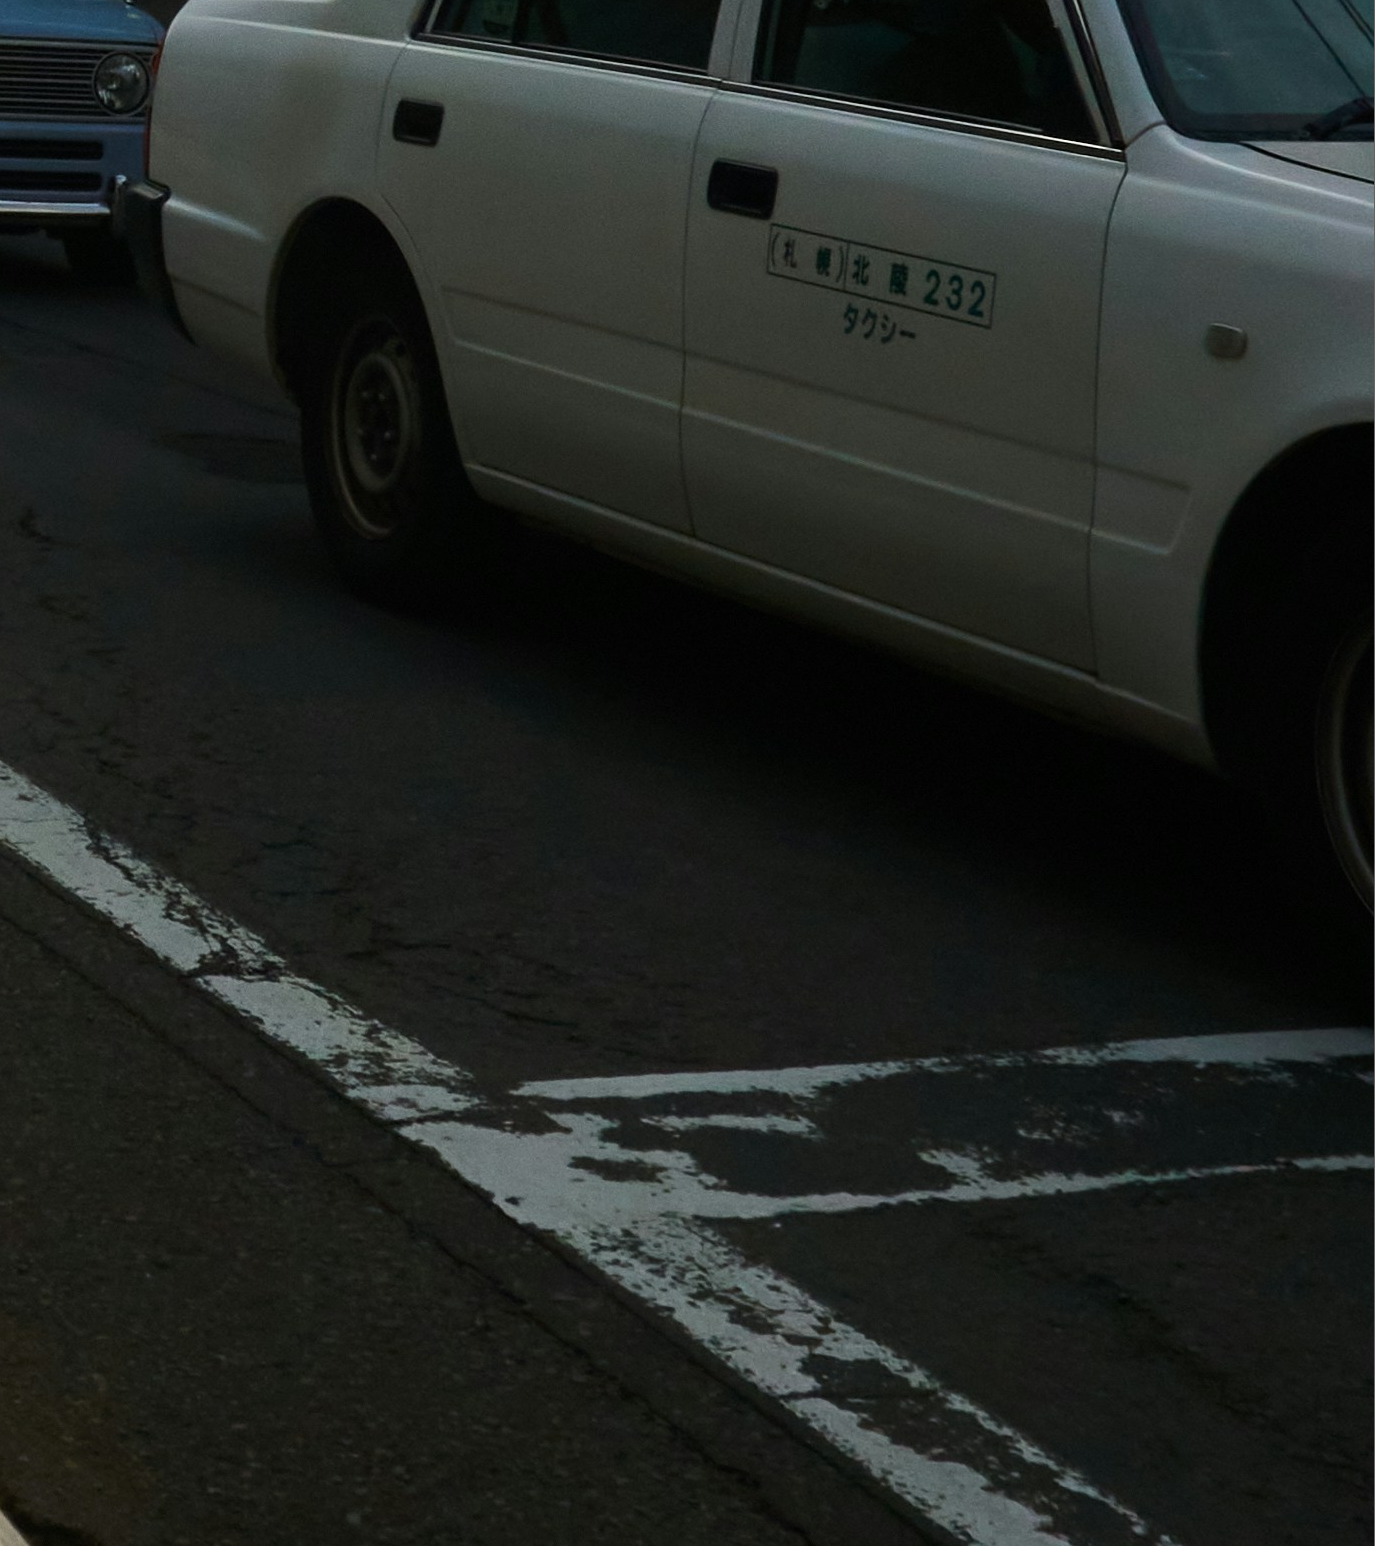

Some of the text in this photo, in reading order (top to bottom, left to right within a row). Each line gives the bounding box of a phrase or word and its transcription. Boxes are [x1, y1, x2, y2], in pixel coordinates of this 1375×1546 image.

[924, 270, 985, 317] 232
[844, 302, 916, 344] タクシー
